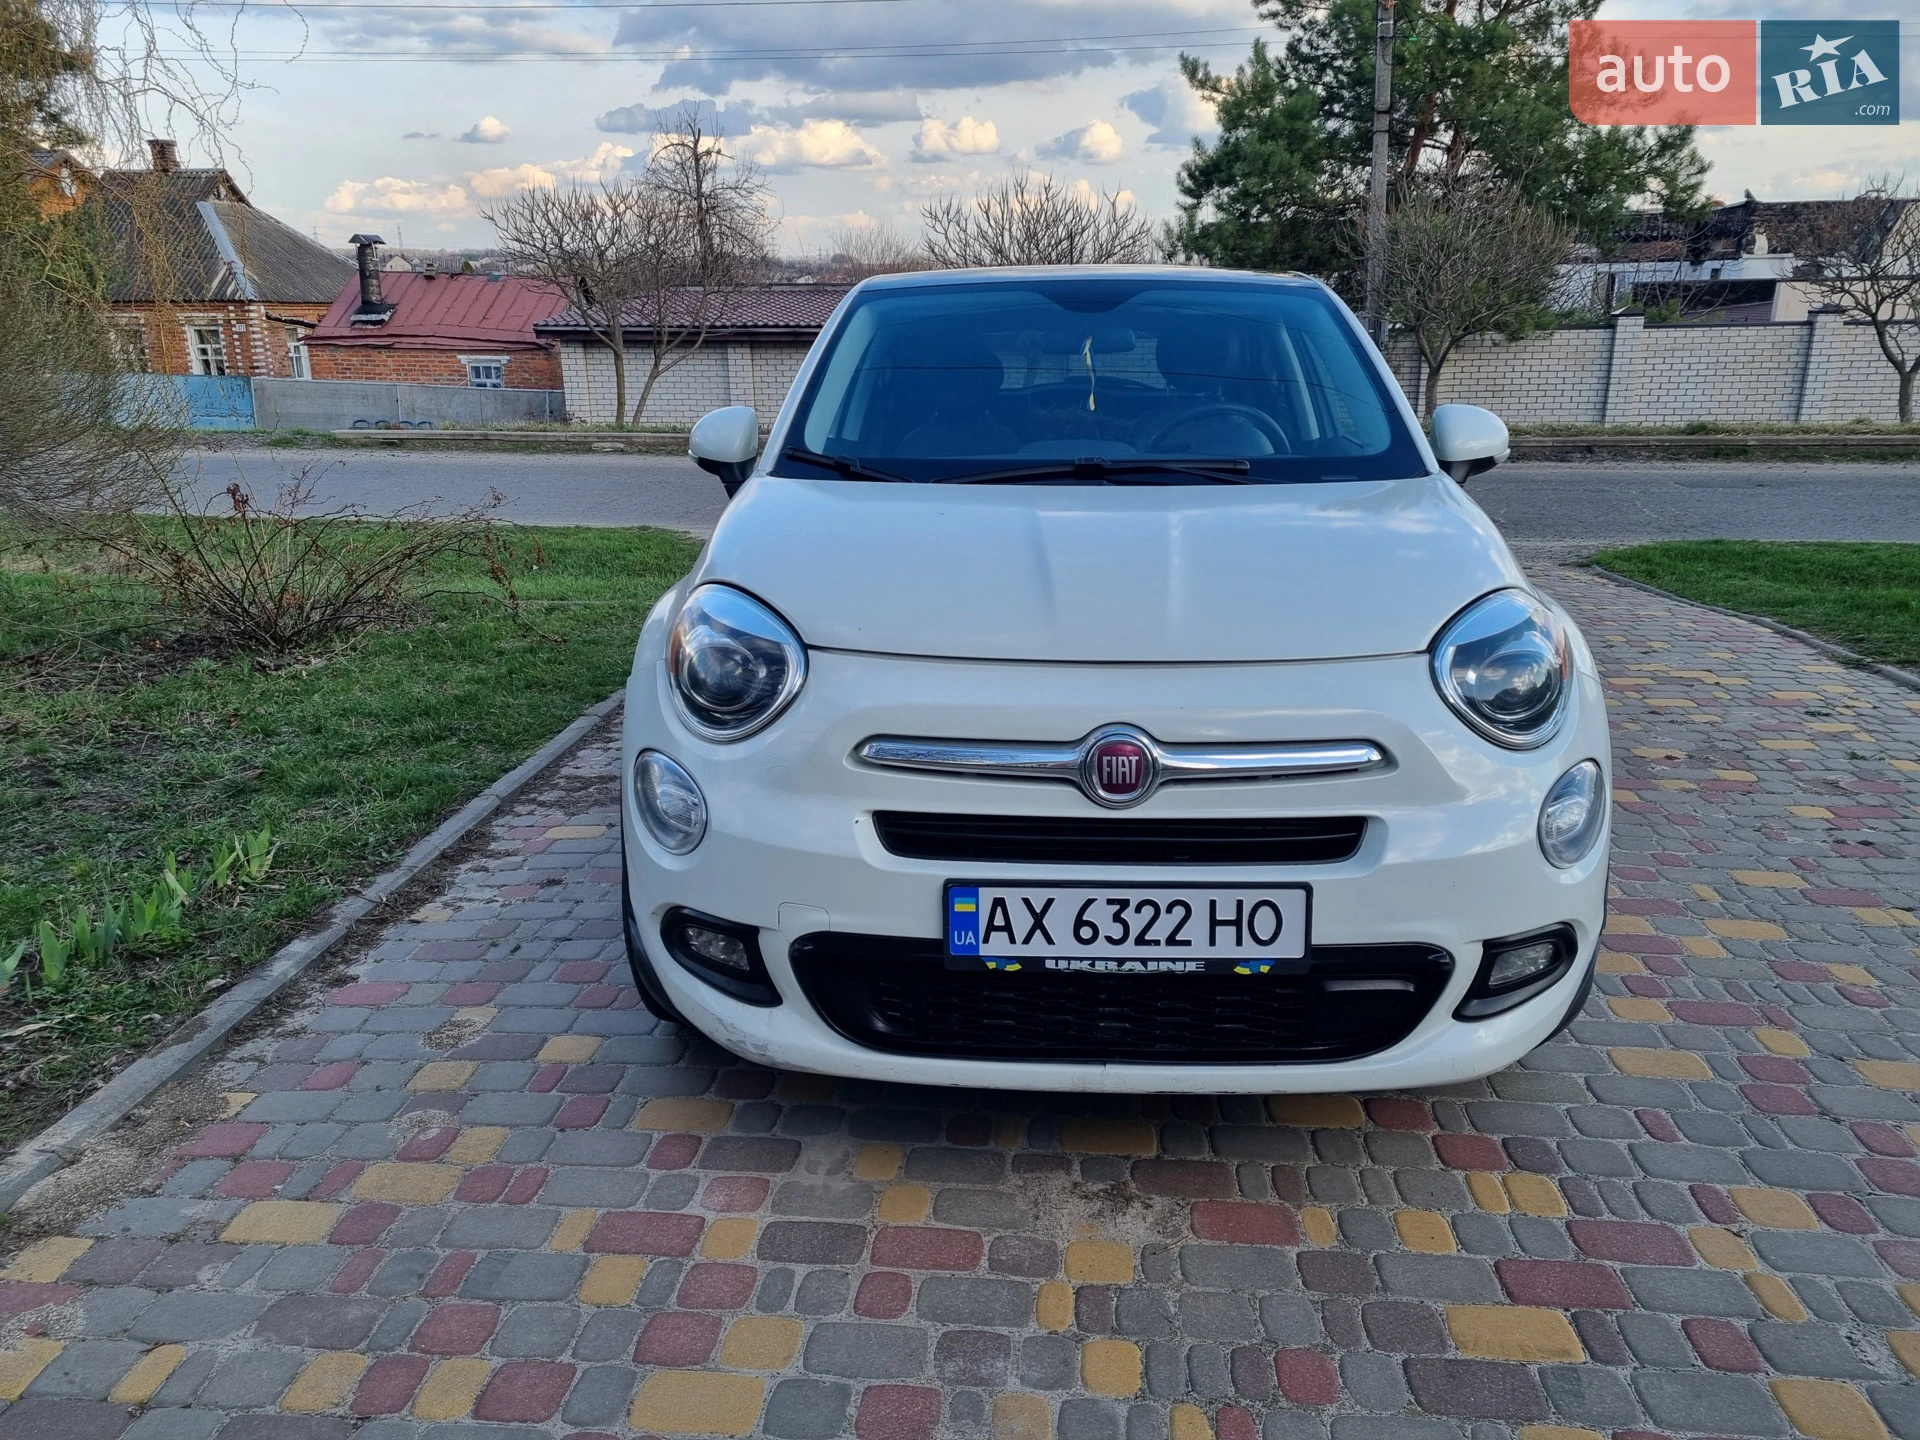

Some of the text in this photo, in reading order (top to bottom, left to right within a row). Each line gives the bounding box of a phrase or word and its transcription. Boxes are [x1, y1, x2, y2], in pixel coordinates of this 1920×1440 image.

[1102, 756, 1139, 784] FIAT
[982, 897, 1283, 947] AX 6322 HO
[954, 930, 976, 946] UA
[1045, 959, 1205, 972] UKRAINE
